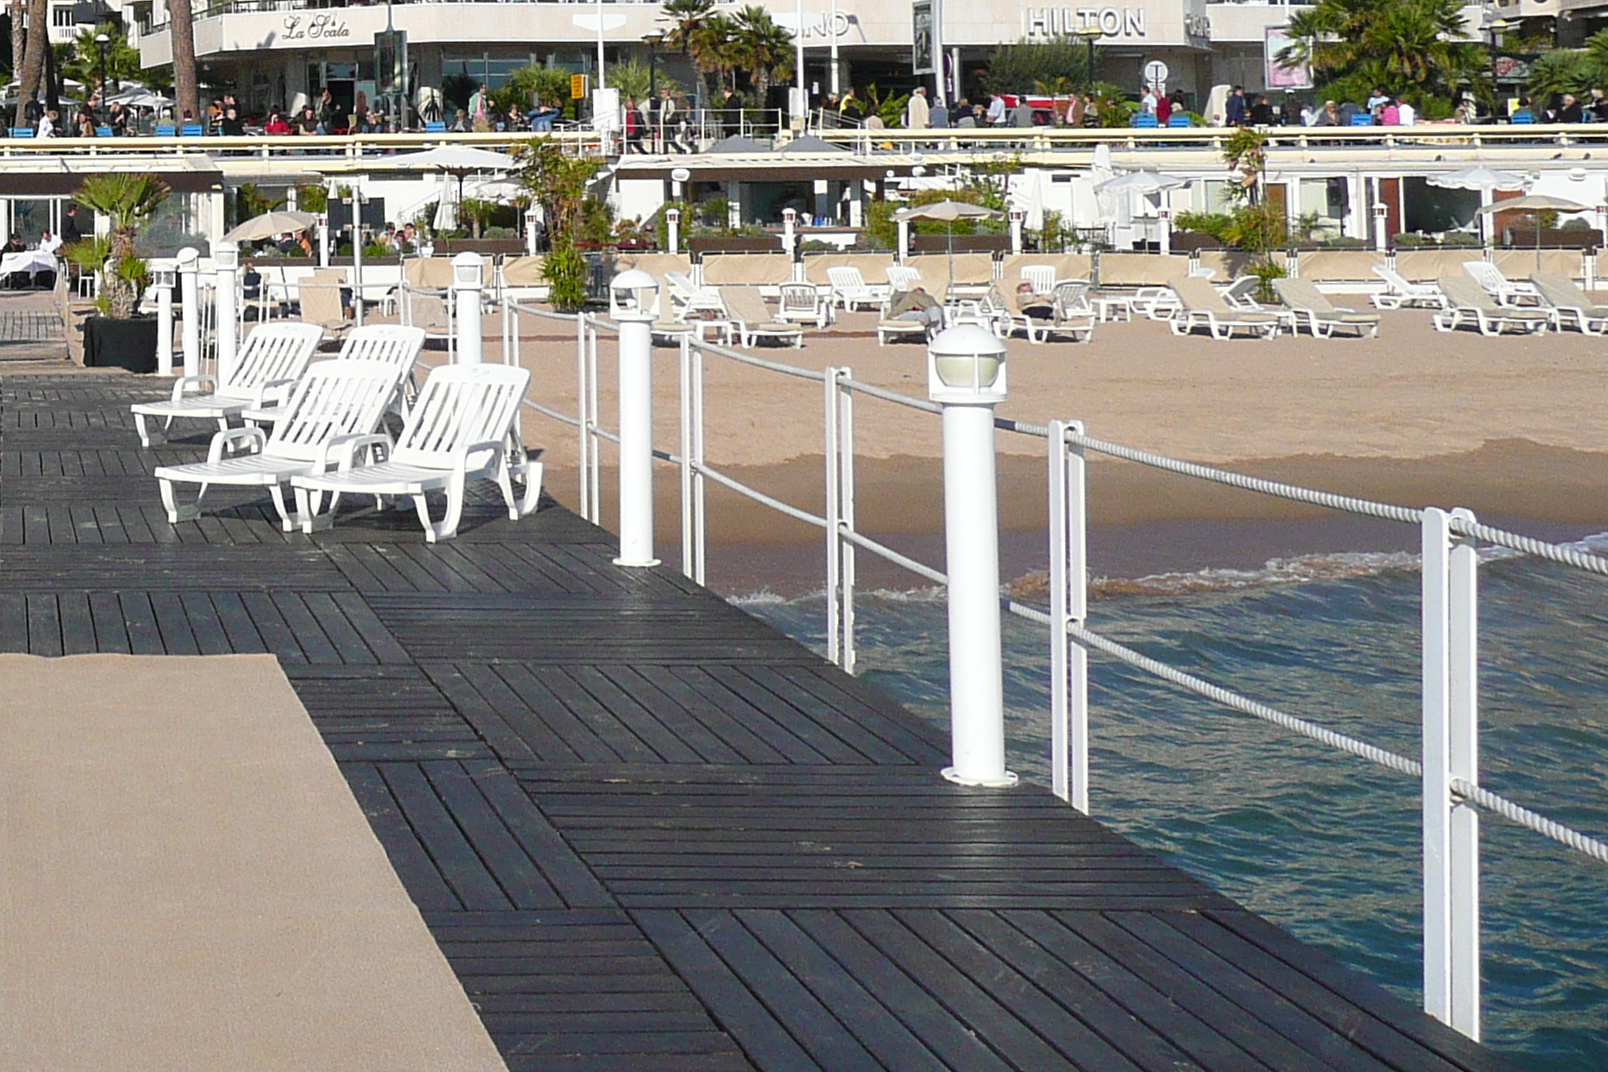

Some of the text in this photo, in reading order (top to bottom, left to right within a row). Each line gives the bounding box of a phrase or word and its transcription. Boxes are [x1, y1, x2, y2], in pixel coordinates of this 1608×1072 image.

[282, 14, 349, 40] La Scala
[1028, 7, 1146, 37] HILTON
